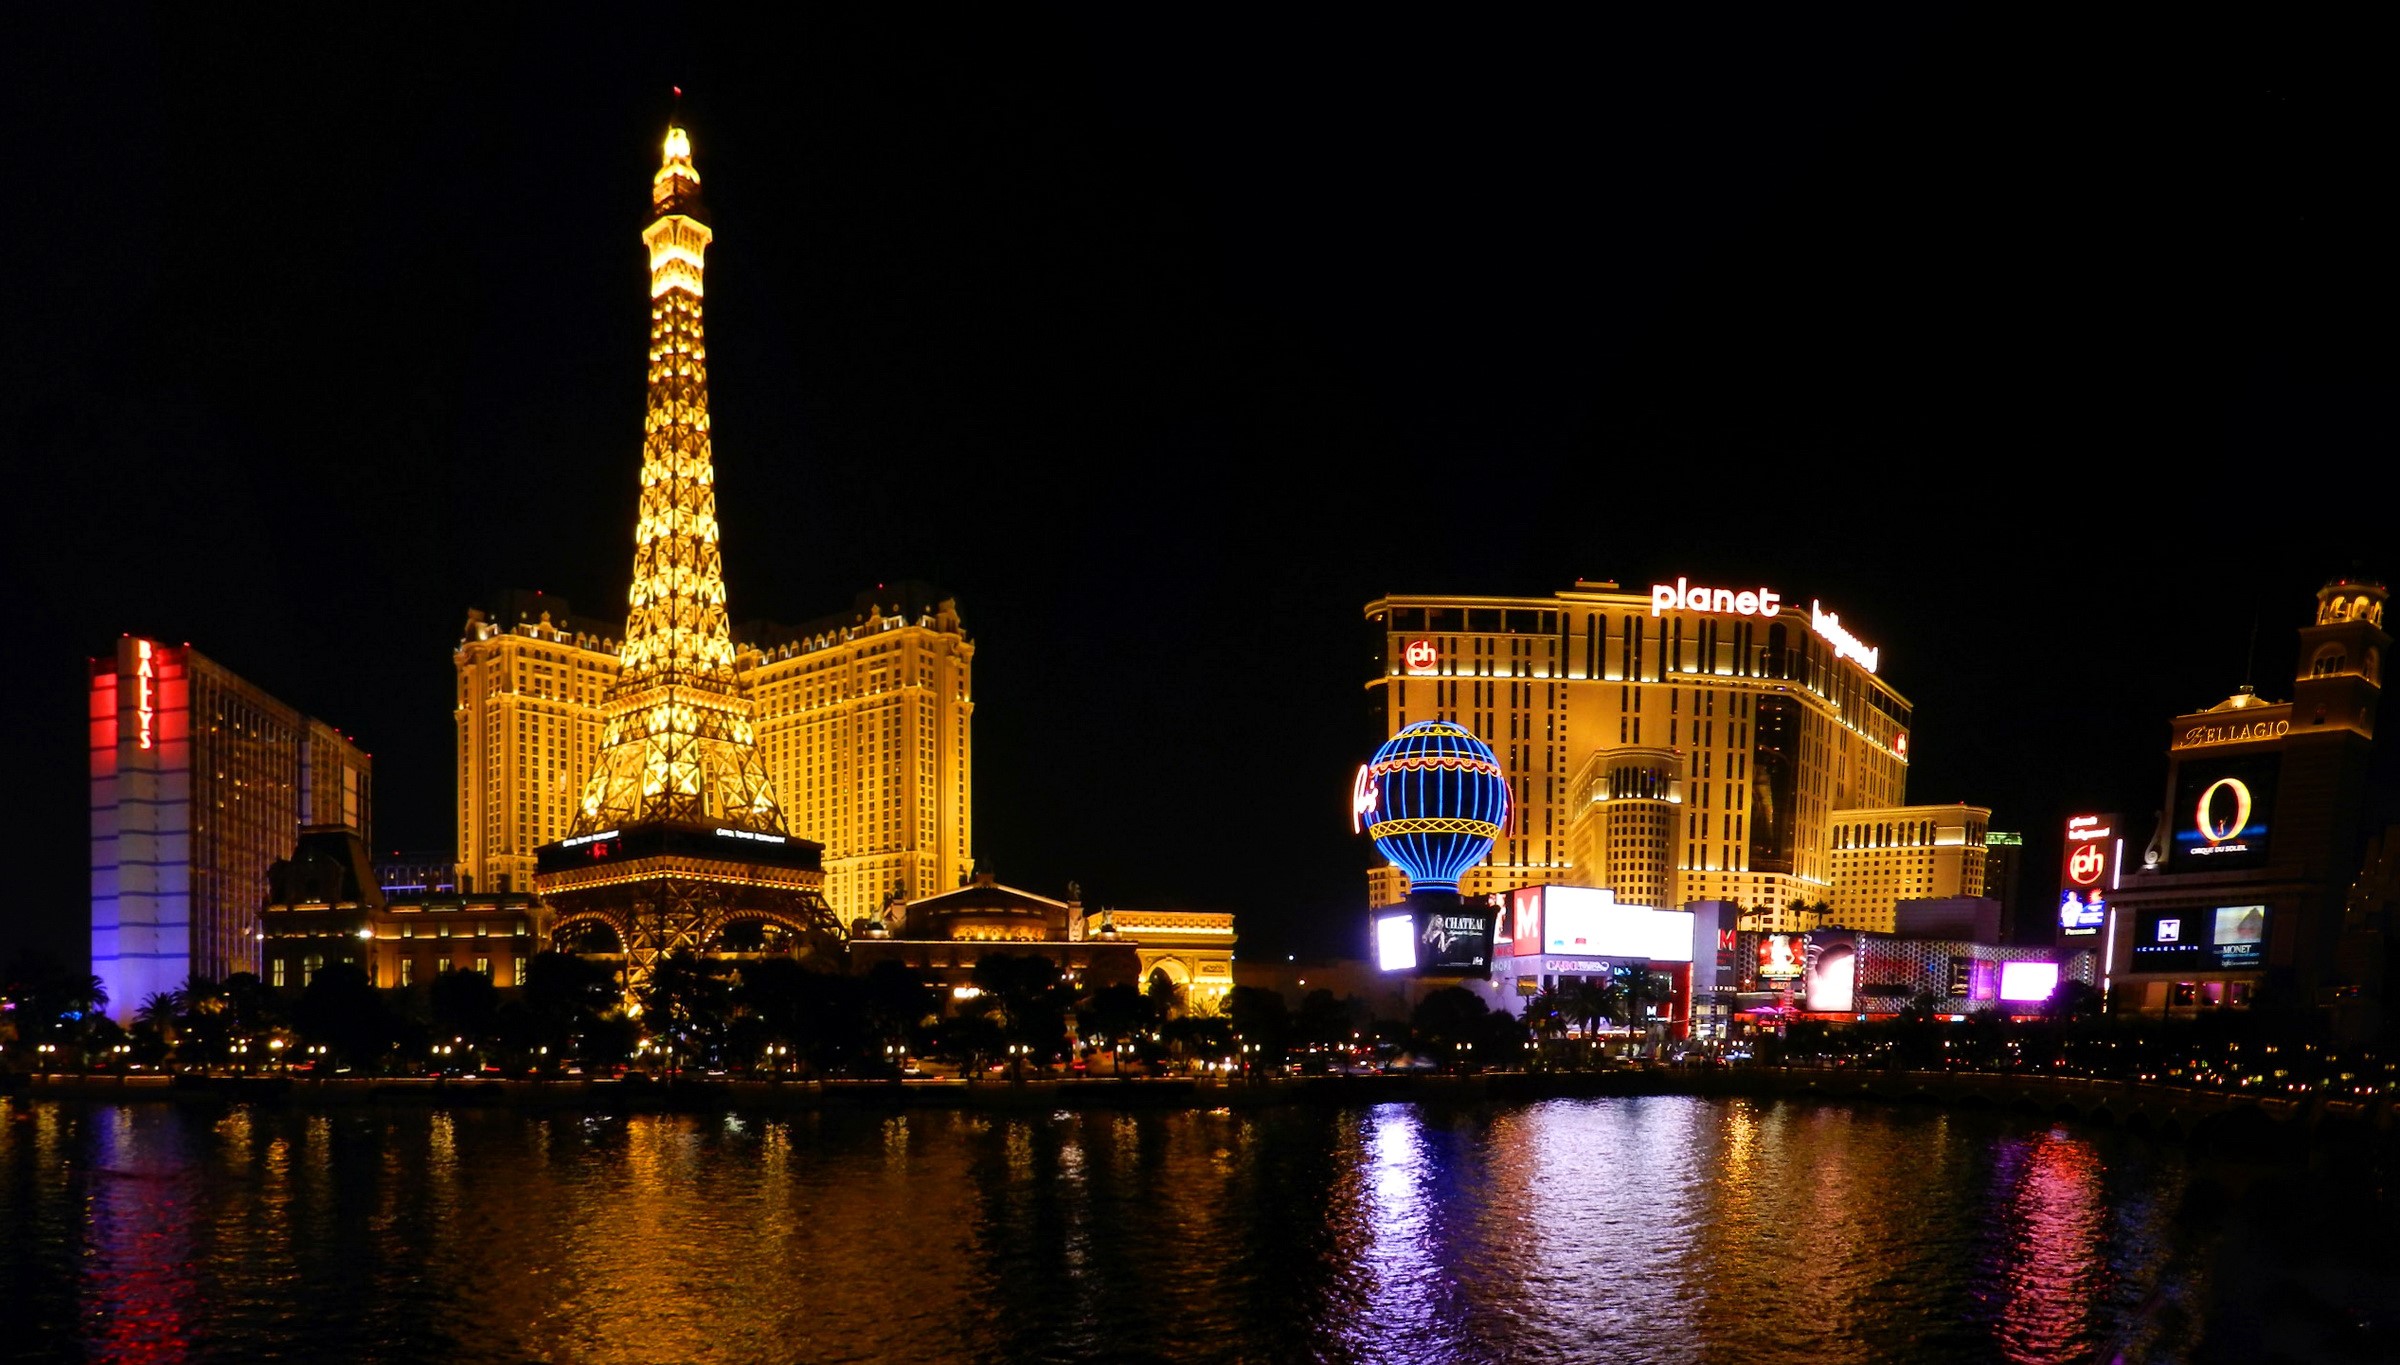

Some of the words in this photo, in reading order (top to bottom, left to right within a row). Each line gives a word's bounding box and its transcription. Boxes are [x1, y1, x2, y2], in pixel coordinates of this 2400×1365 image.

[1651, 576, 1780, 617] planet
[1410, 641, 1436, 666] ph
[2180, 720, 2289, 747] BELLAGIO
[2195, 778, 2251, 841] O
[2074, 845, 2104, 881] ph
[2222, 944, 2252, 954] MONET
